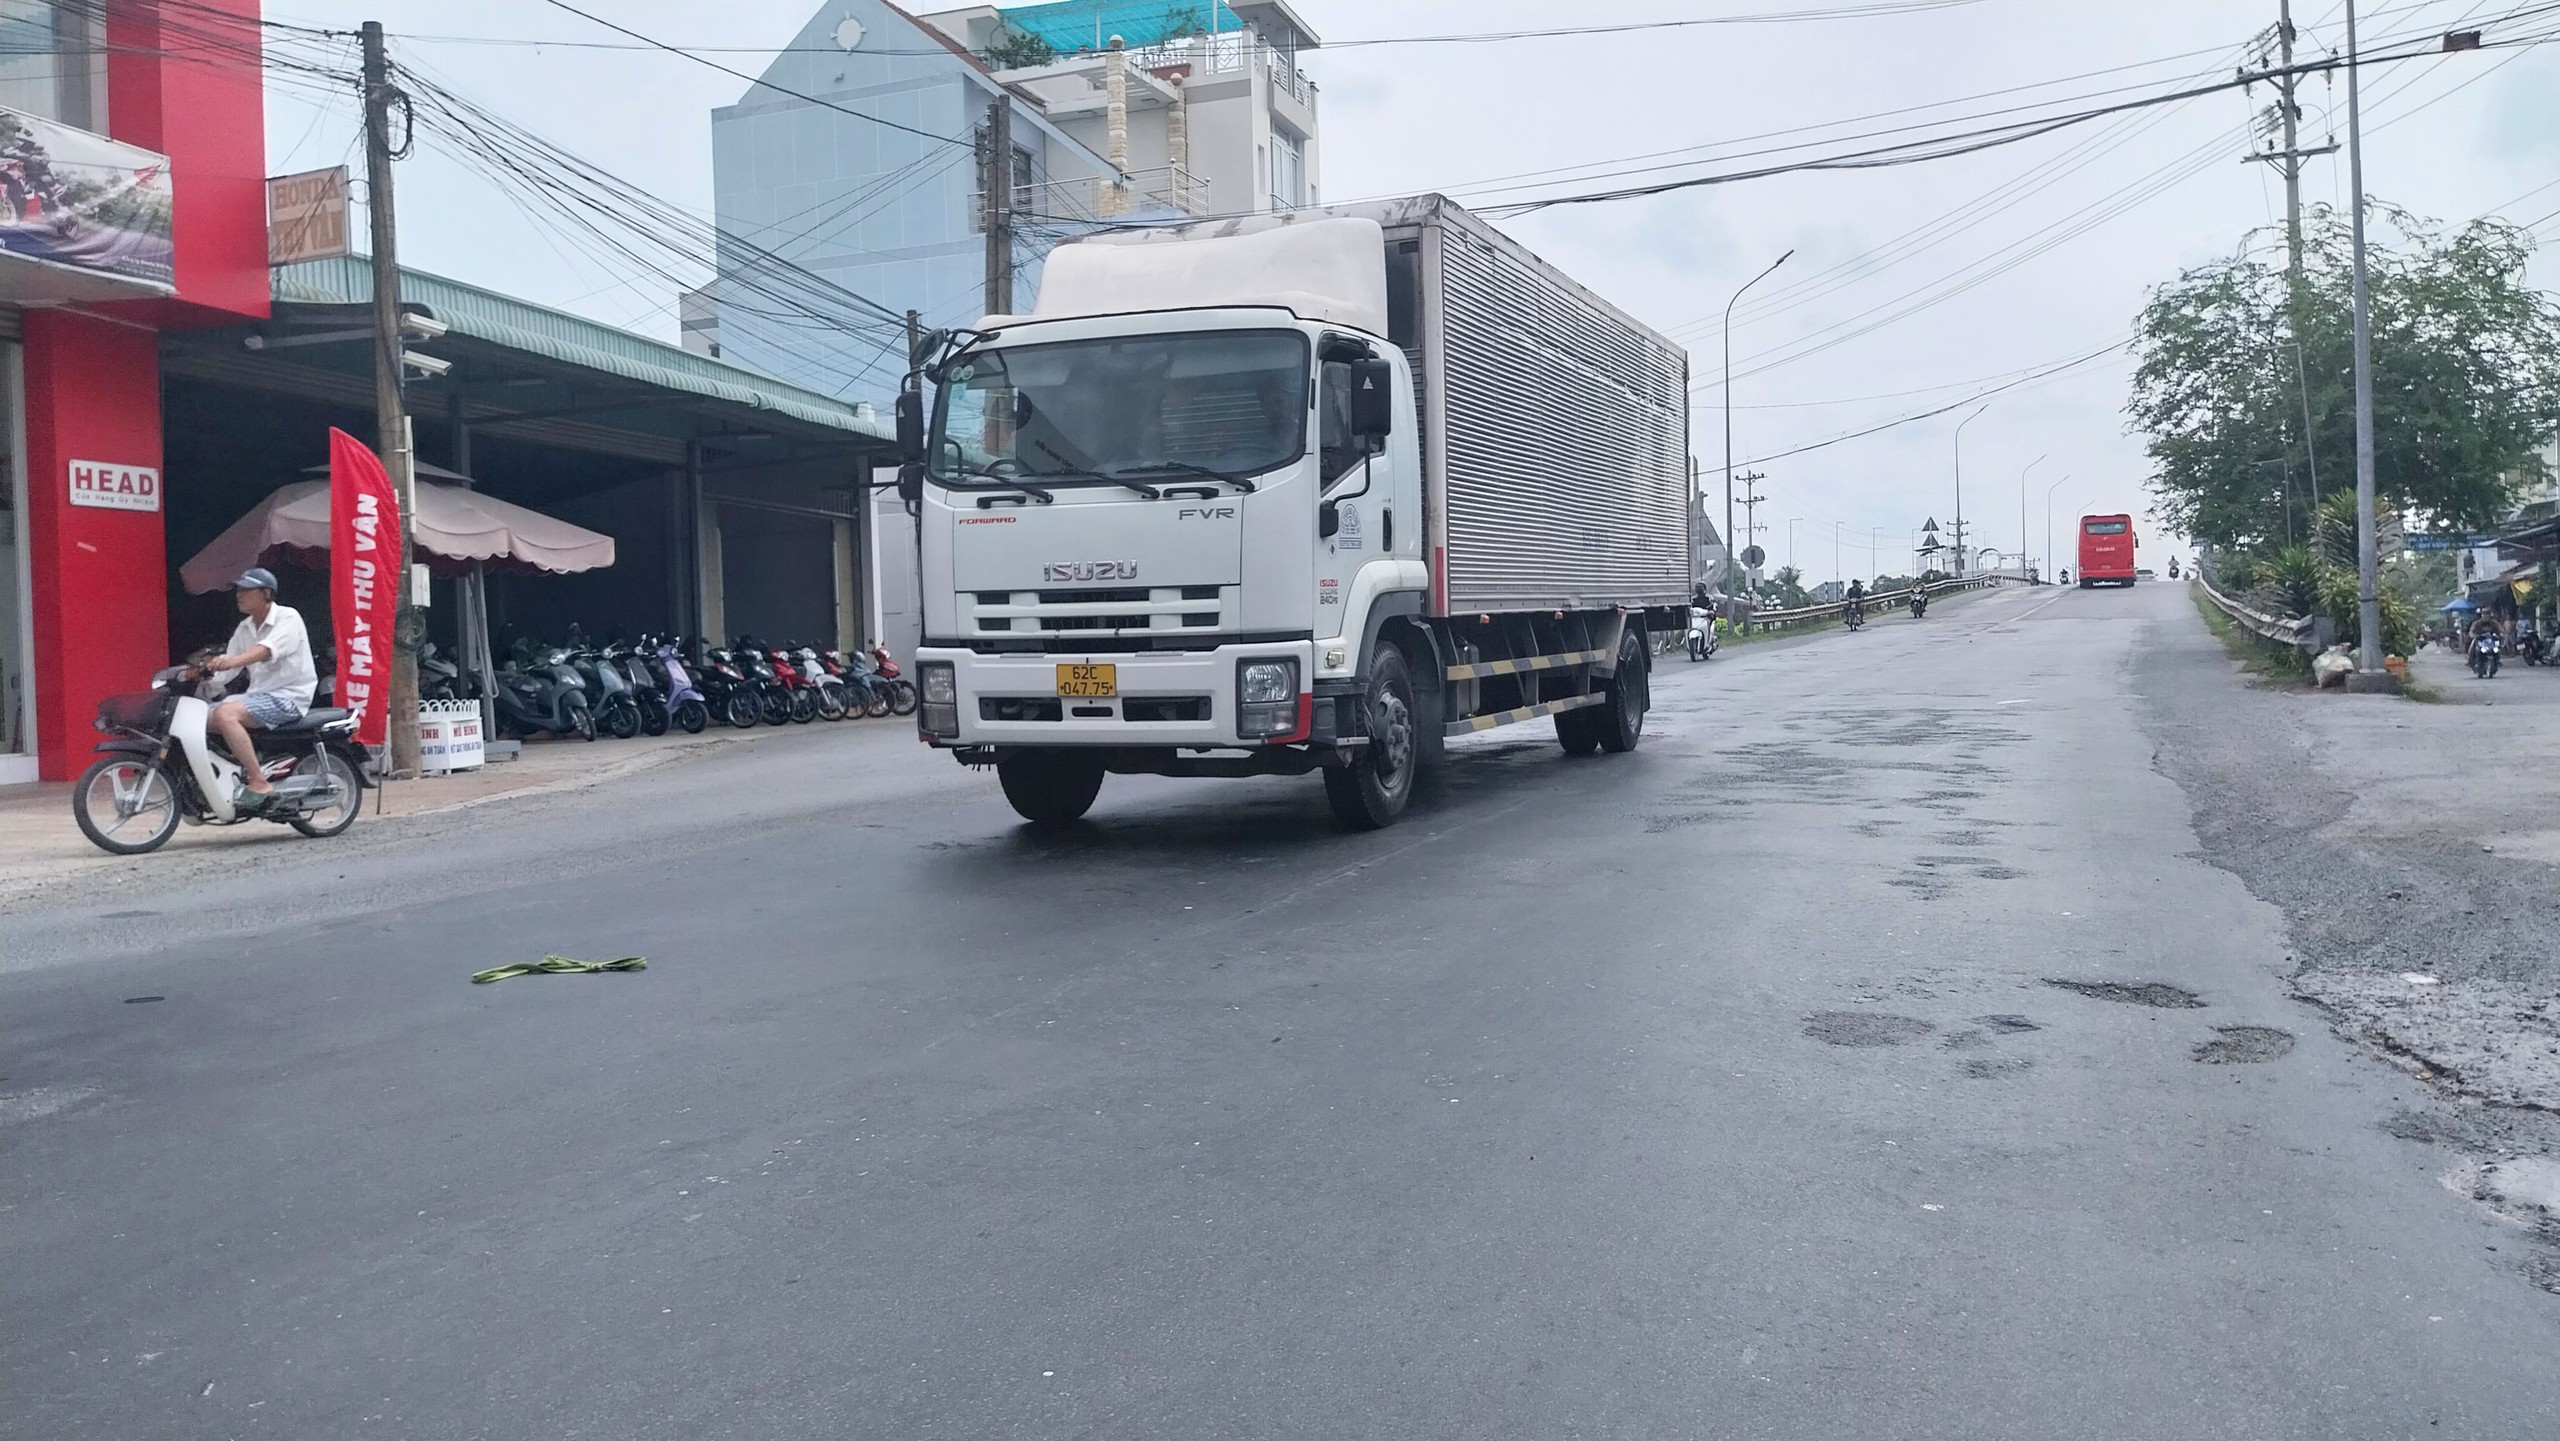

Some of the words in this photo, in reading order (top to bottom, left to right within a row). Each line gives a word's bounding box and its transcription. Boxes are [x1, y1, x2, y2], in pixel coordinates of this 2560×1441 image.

[75, 467, 154, 496] HEAD
[352, 493, 379, 551] VÂN
[959, 516, 1016, 525] FORWARD
[1179, 507, 1234, 520] FVR
[1043, 559, 1138, 582] ISUZU
[353, 559, 375, 610] THU
[1319, 579, 1338, 587] ISUZU
[346, 615, 372, 677] MÁY
[1072, 666, 1098, 680] 62C
[1063, 681, 1110, 695] 047.75
